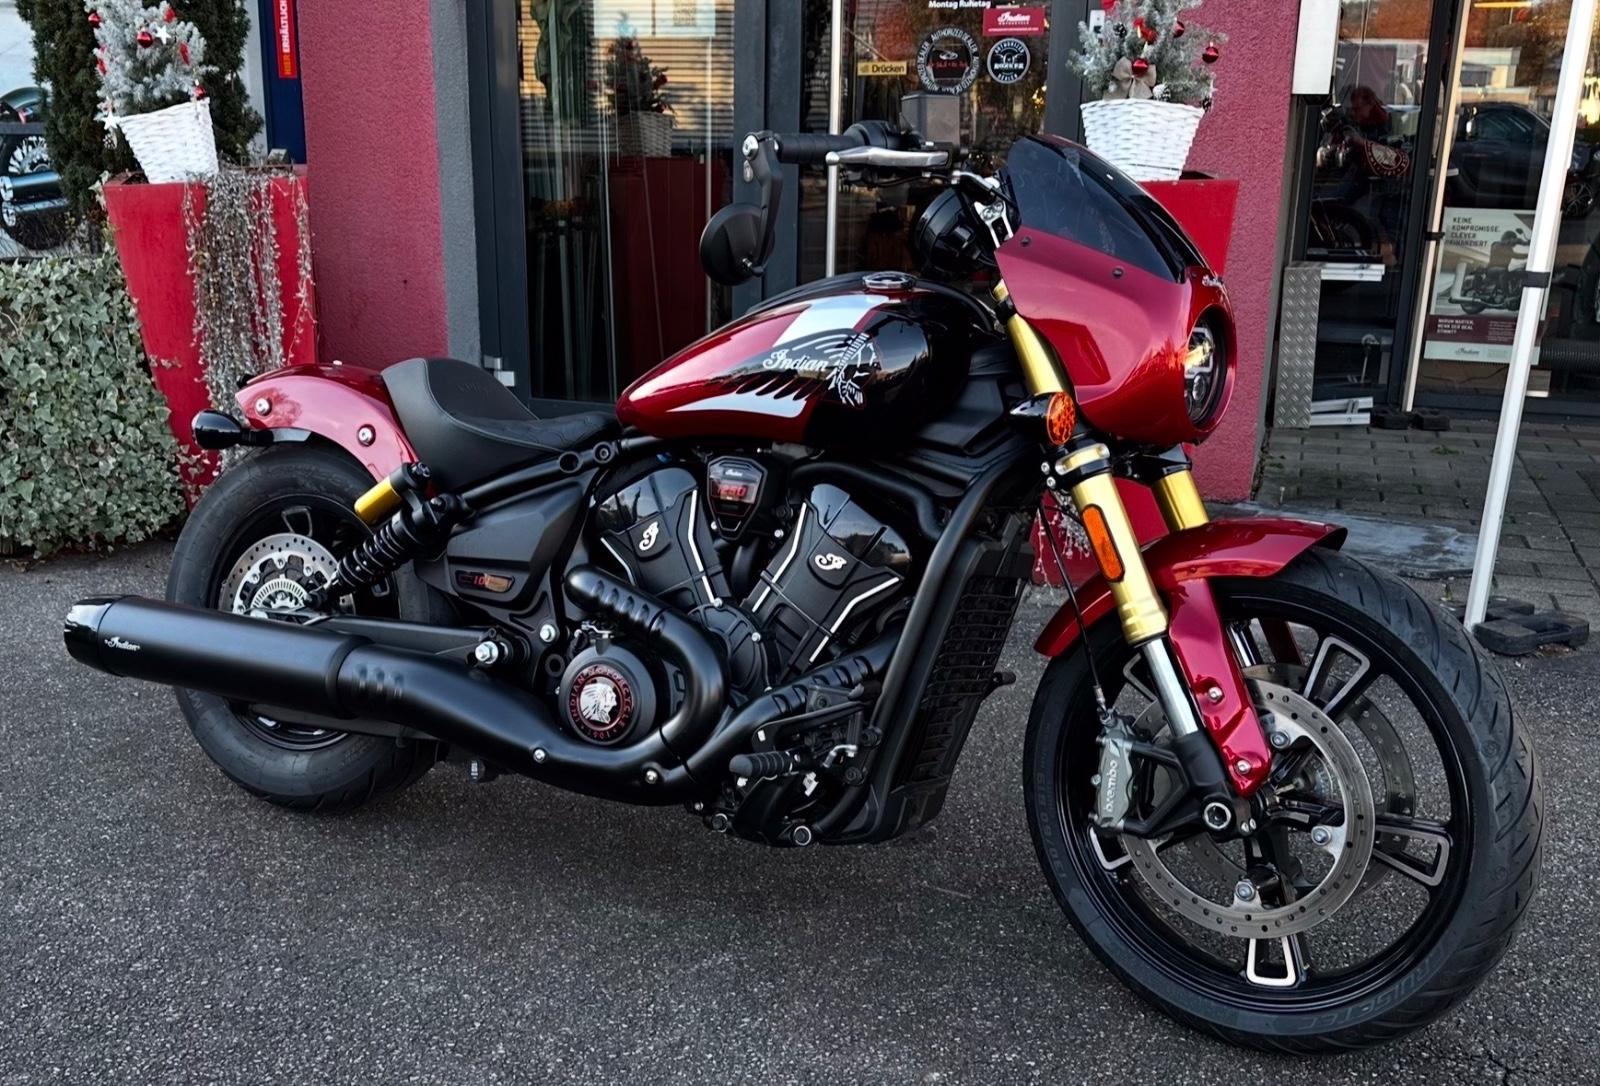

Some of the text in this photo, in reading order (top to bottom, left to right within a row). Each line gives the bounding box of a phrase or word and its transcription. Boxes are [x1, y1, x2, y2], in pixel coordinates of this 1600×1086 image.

[928, 0, 991, 9] Montag Ruhetag
[931, 28, 963, 41] AUTHORIZED
[871, 64, 905, 73] Drücken
[762, 349, 829, 372] Indian
[105, 636, 141, 651] Indian
[570, 672, 587, 722] INDIAN
[1103, 760, 1118, 812] brembo
